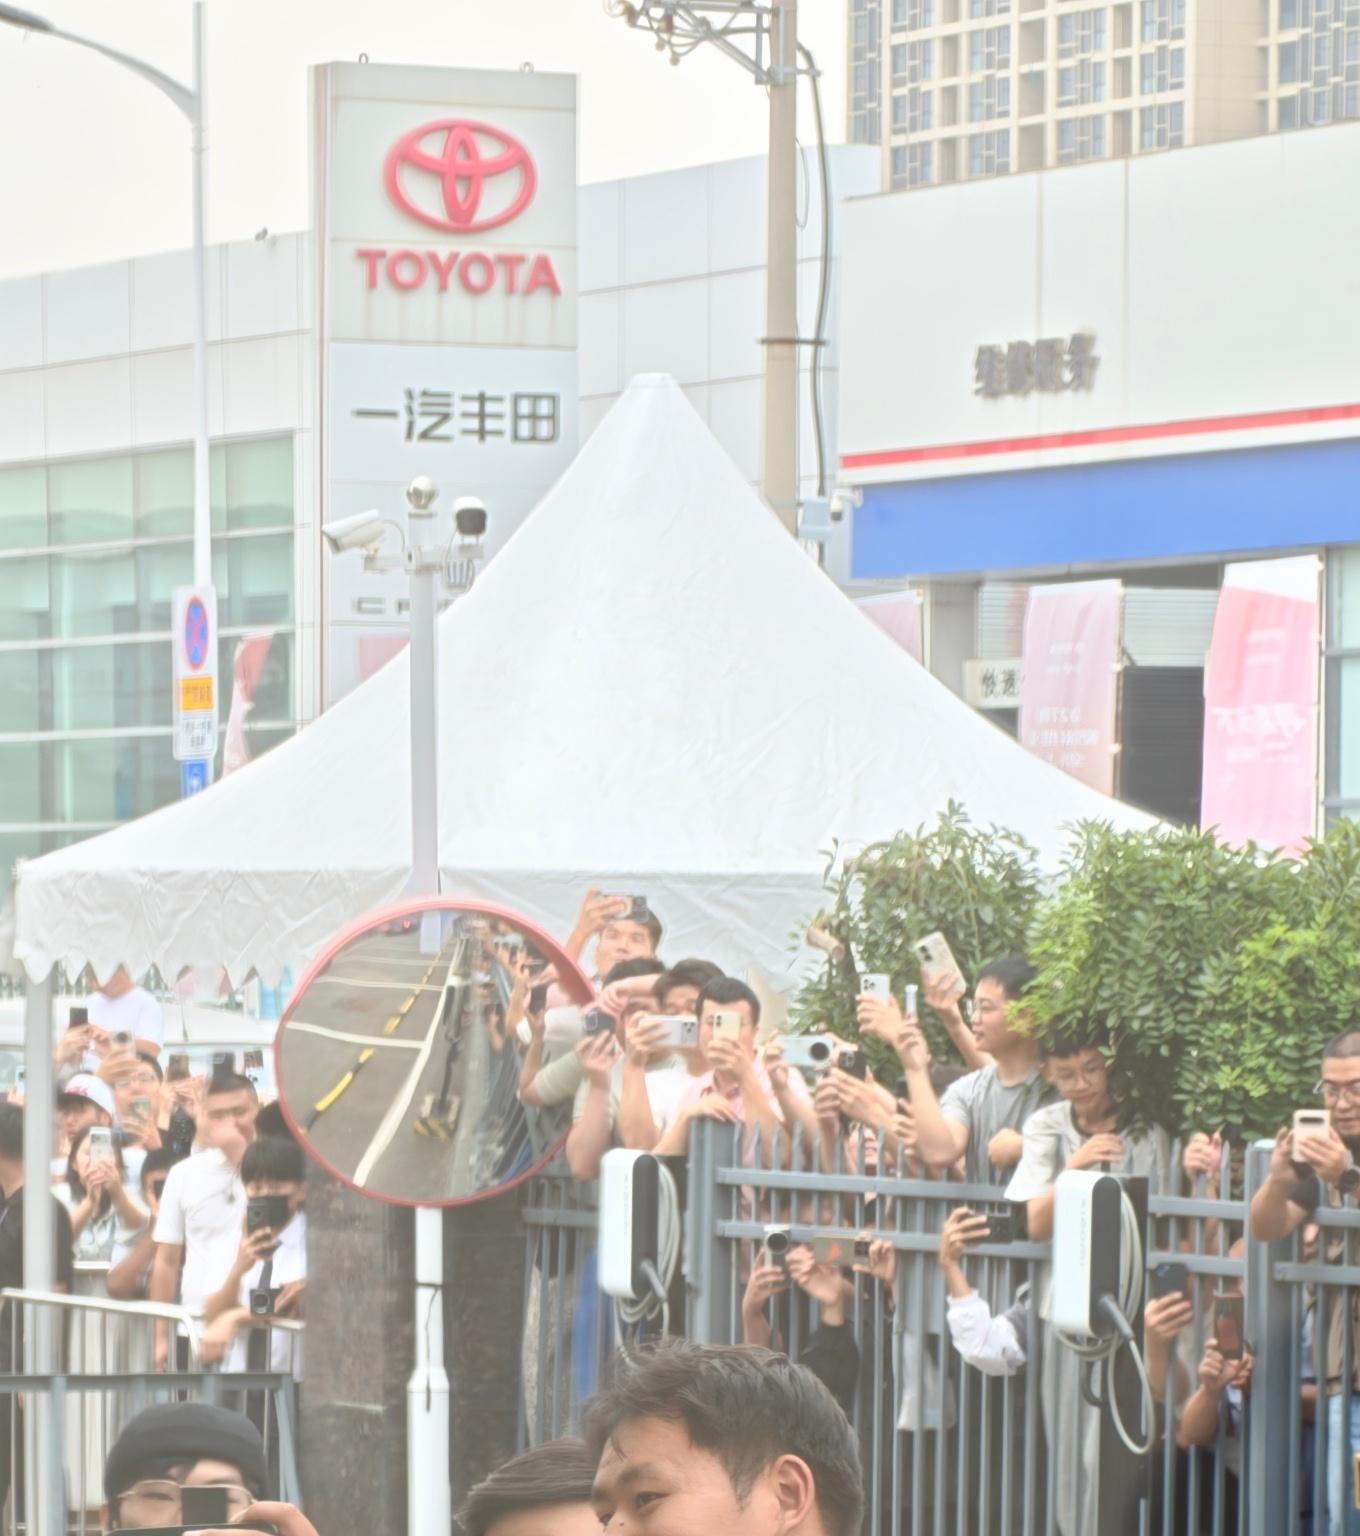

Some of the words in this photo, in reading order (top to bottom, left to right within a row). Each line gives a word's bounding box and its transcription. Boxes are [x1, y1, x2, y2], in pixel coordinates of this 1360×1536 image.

[355, 248, 562, 296] TOYOTA
[352, 387, 561, 443] 一汽丰田
